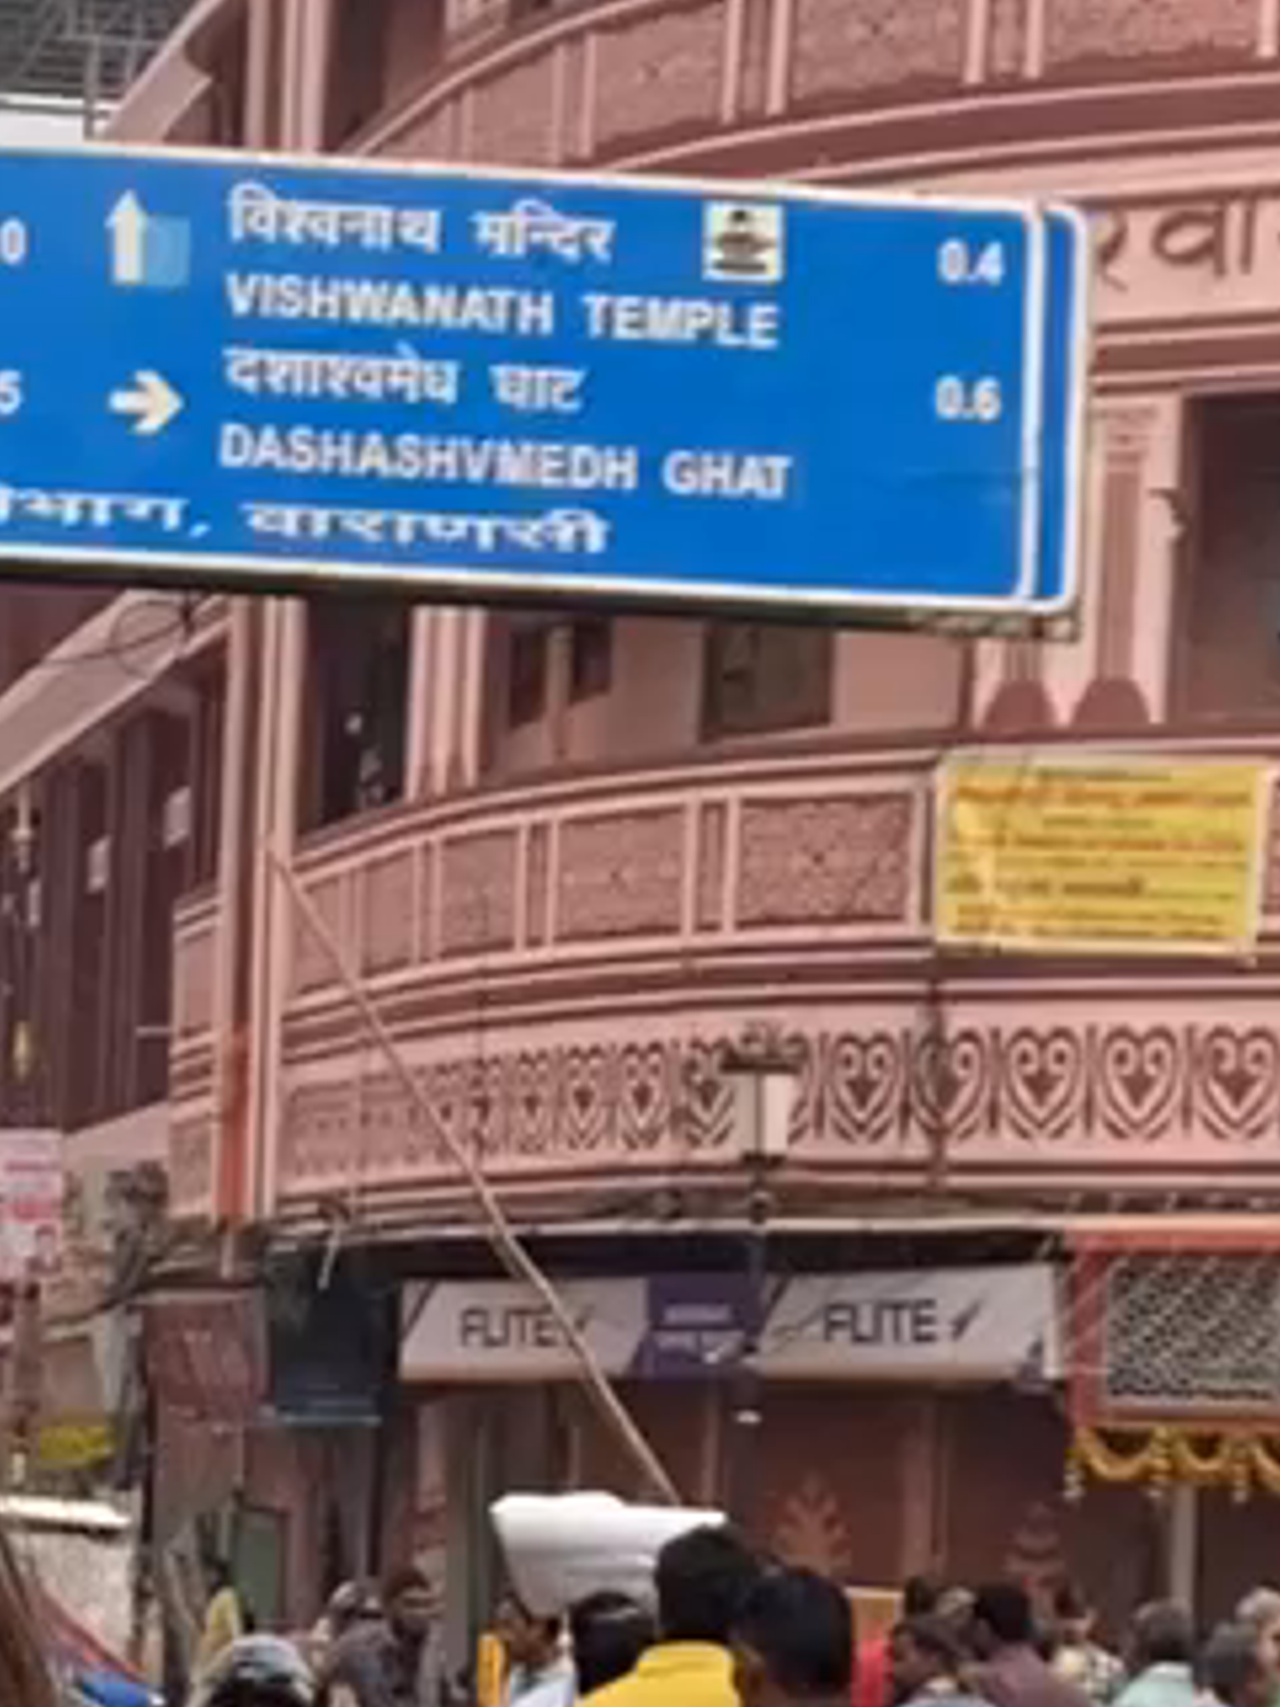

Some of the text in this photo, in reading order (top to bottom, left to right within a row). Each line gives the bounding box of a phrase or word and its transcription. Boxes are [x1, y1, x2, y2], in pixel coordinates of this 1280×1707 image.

[228, 181, 617, 263] विश्वनाथ मन्दिर
[937, 239, 1004, 285] 0.4
[225, 272, 780, 350] VISHWANATH TEMPLE
[222, 339, 587, 412] दशाश्वमेध घाट
[934, 377, 1001, 421] 0.6
[219, 423, 793, 499] DASHASHVMEDH GHAT
[240, 501, 610, 553] वाराणसी
[459, 1307, 554, 1349] FLITE
[822, 1299, 937, 1346] FLITE
